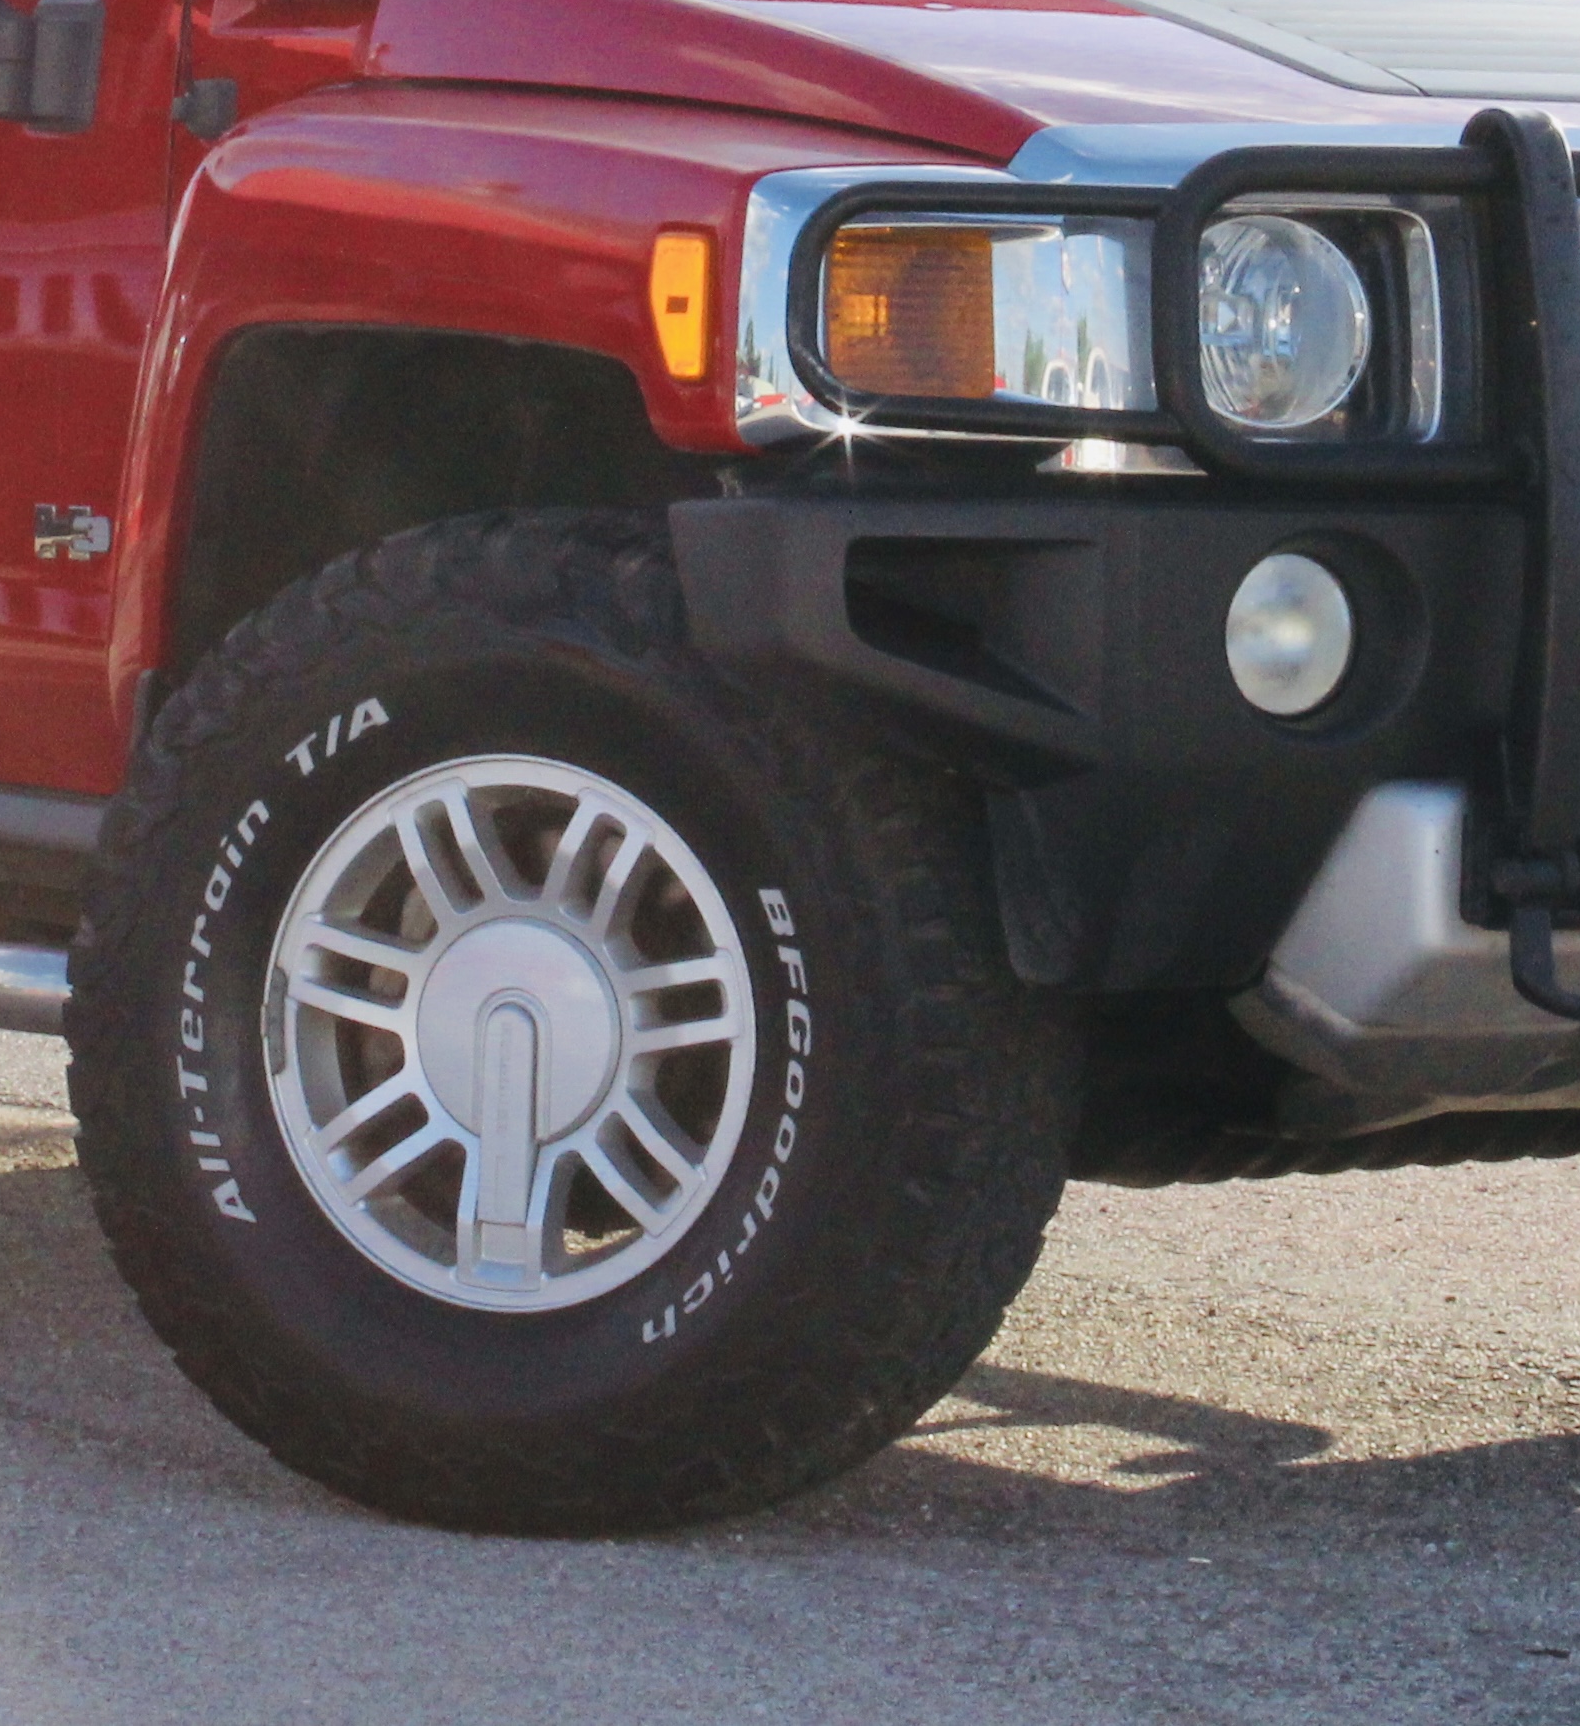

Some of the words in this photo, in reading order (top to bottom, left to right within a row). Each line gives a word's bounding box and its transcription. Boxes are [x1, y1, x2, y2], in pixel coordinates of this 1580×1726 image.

[176, 800, 271, 1224] All-Terrain
[285, 697, 391, 777] T/A
[642, 888, 811, 1345] BFGoodrich
